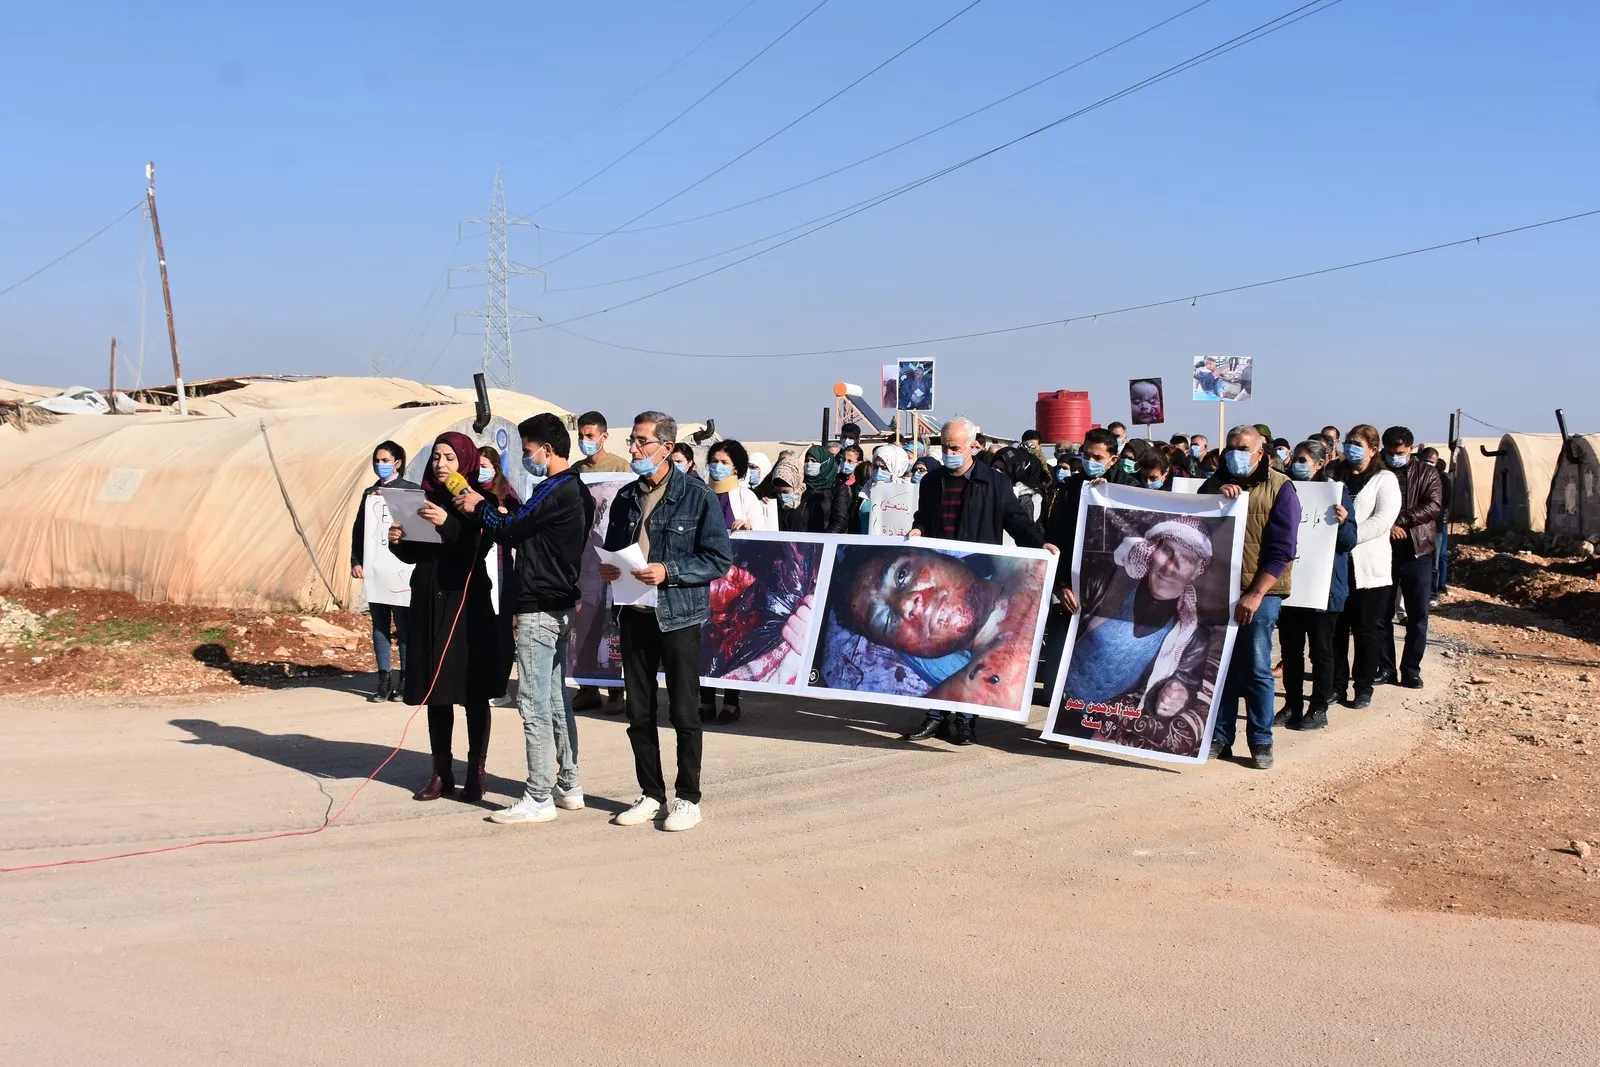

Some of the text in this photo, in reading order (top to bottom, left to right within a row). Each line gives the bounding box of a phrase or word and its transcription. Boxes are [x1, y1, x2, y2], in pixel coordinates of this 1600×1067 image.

[1086, 701, 1122, 716] الرحمن
[1122, 706, 1141, 720] عبد
[1081, 714, 1102, 729] سنة
